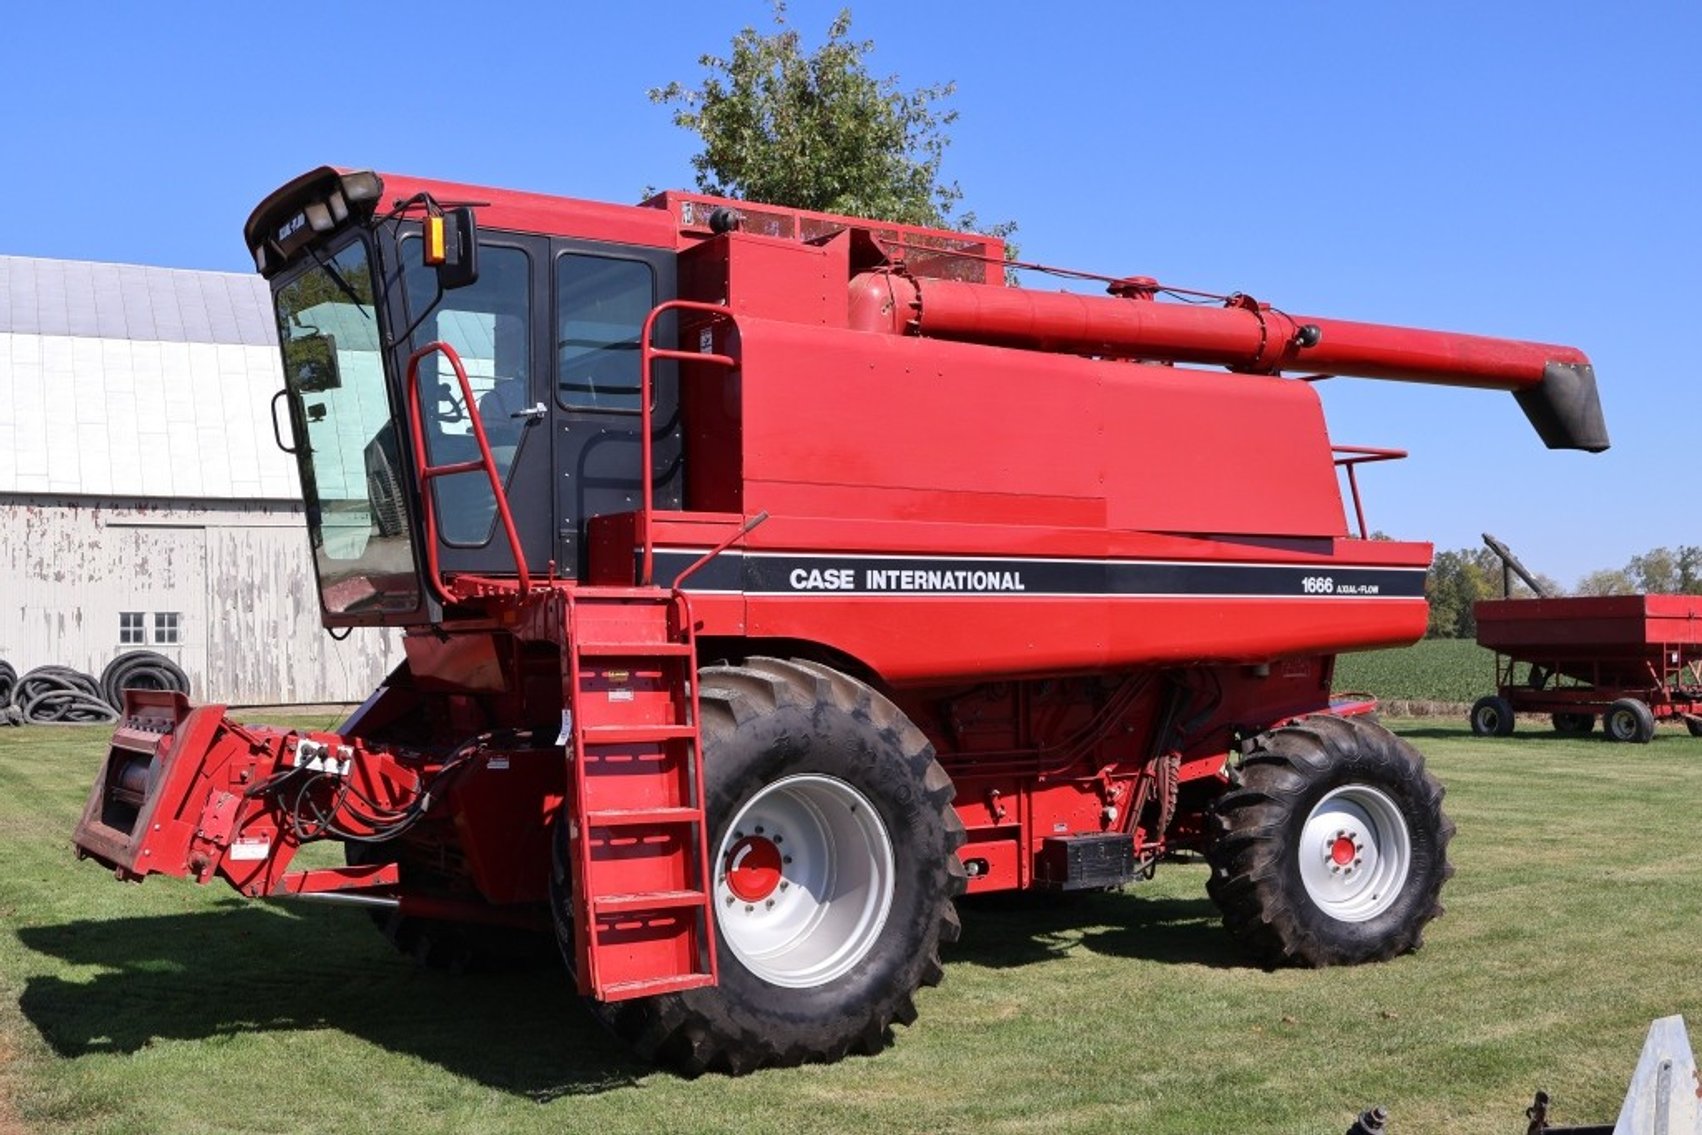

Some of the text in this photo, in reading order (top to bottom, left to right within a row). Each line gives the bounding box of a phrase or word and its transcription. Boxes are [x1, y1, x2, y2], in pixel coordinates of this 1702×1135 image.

[789, 568, 1025, 591] CASE INTERNATIONAL
[1301, 576, 1379, 594] 1666 AXIAL-FLOW
